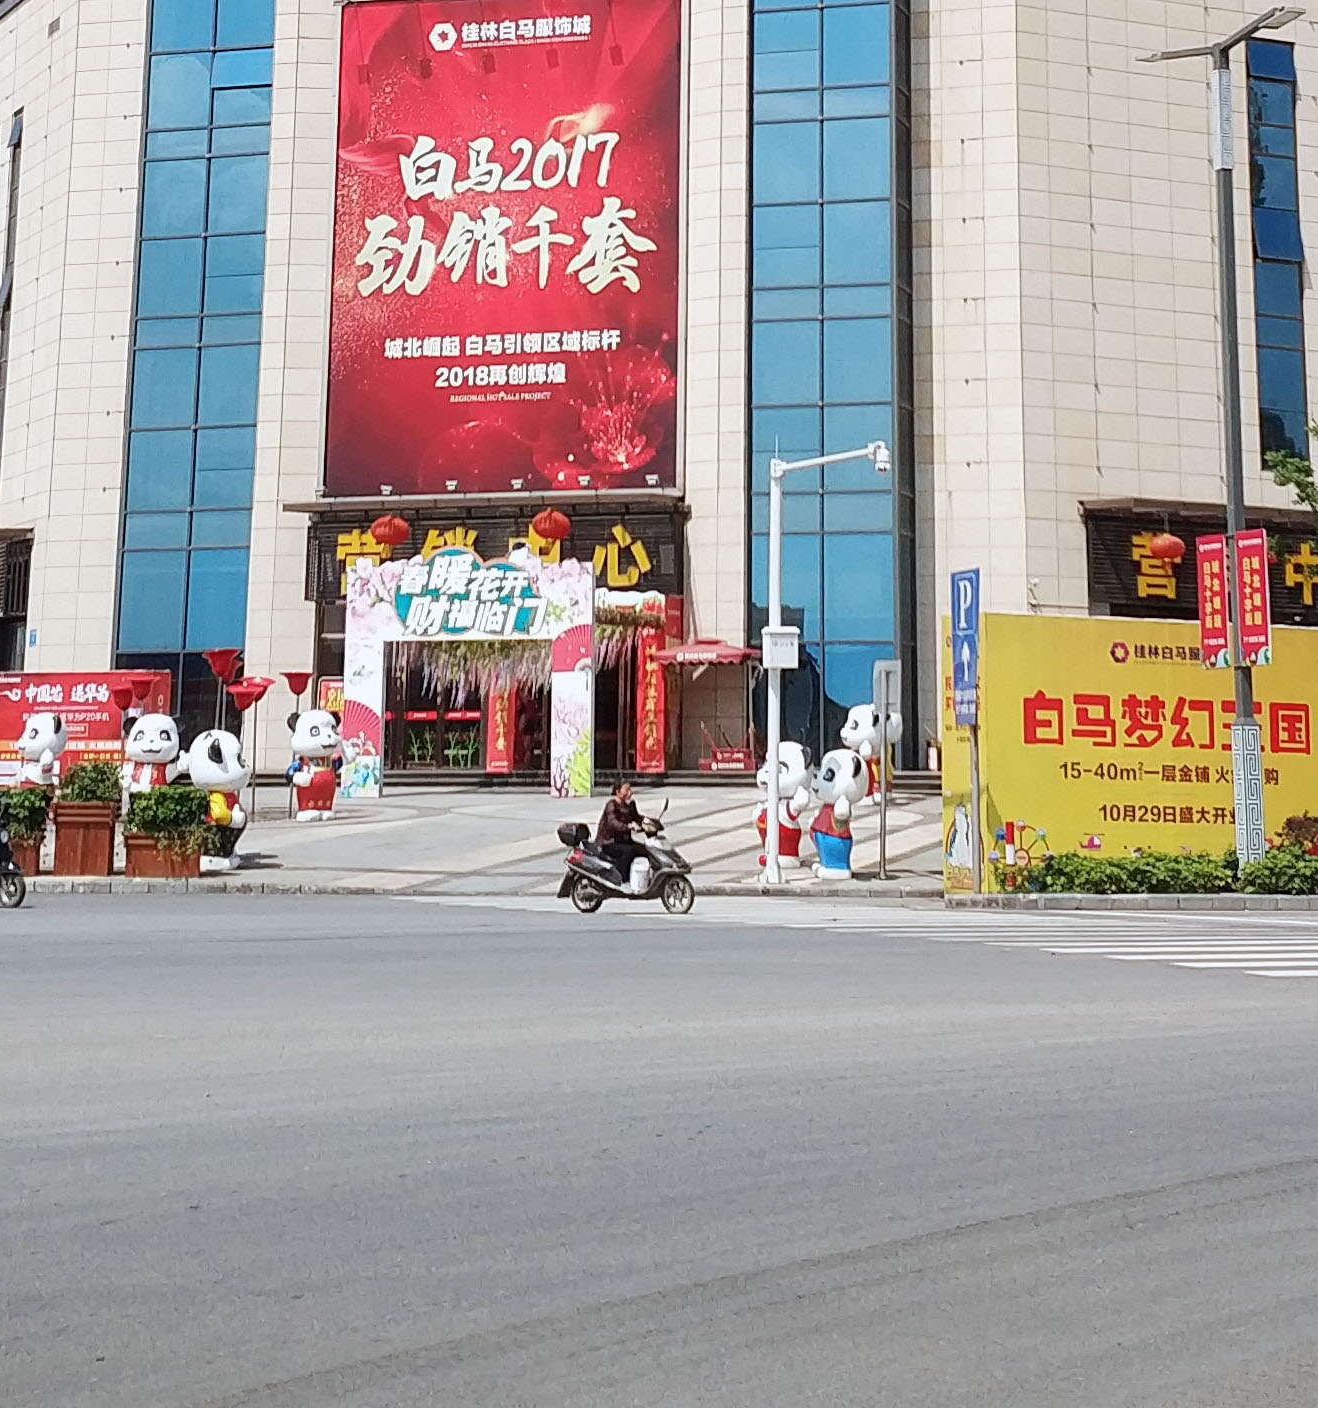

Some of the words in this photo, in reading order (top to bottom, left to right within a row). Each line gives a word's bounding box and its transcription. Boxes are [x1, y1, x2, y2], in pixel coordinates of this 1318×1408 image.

[461, 15, 591, 42] 桂林白马服饰城
[399, 133, 620, 201] 白马2017
[355, 197, 658, 298] 劲销千套
[384, 336, 461, 359] 城北崛起
[466, 329, 621, 356] 白马引领区域标杆
[435, 362, 567, 387] 2018再创辉煌
[399, 553, 532, 602] 春暖花开
[402, 595, 550, 636] 财福临门
[958, 578, 972, 629] P
[1215, 766, 1279, 787] 火购
